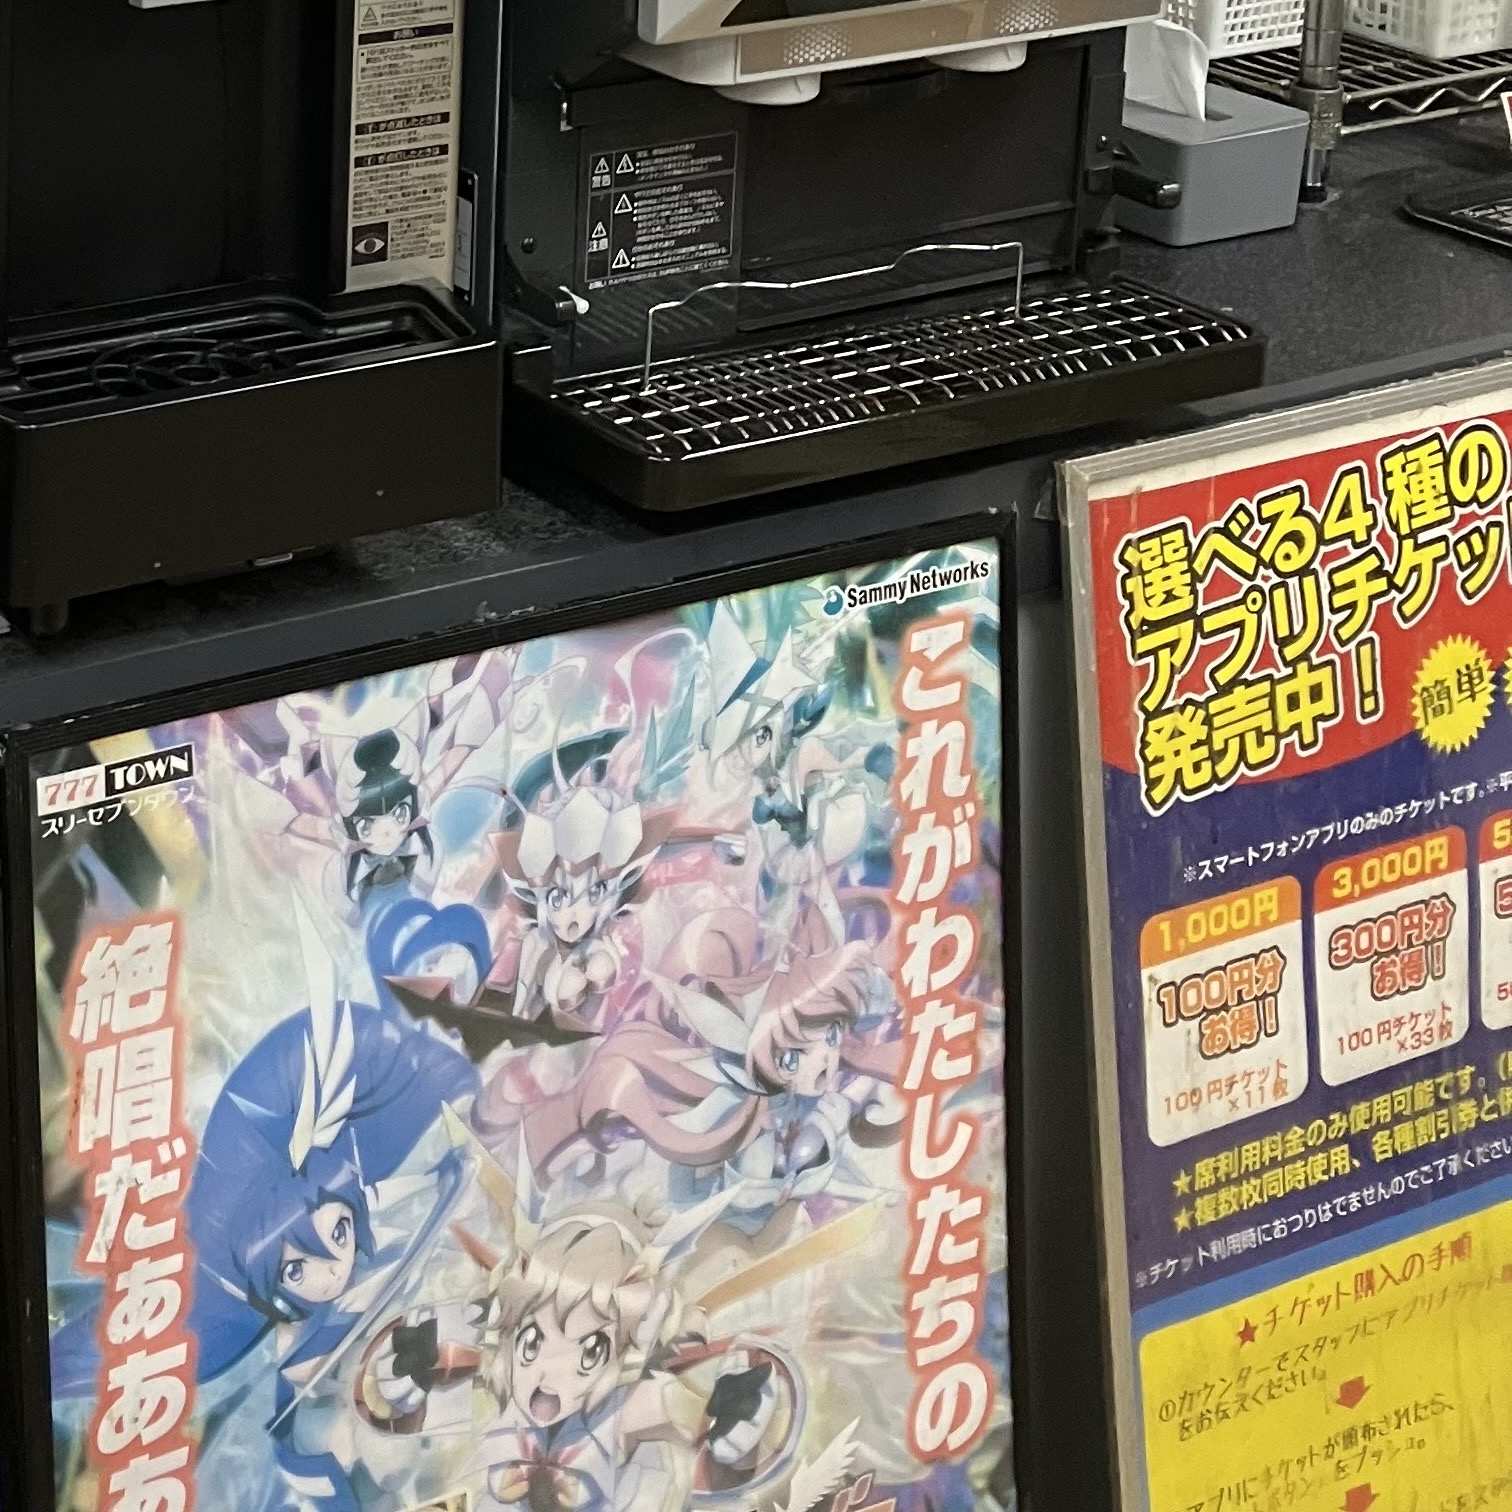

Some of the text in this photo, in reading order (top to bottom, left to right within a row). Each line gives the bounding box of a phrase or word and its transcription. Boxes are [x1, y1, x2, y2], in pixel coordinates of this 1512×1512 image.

[1118, 425, 1507, 631] 選べる4種の
[1131, 496, 1512, 712] アプリチケッ
[1144, 636, 1380, 806] 発売中！
[1419, 658, 1488, 725] 簡単
[41, 785, 196, 838] スリーセブンタウン
[44, 752, 189, 807] 777 TOWN
[1333, 836, 1450, 899] 3,000円
[1159, 886, 1279, 953] 1,000円
[1328, 891, 1457, 971] 300円分
[1158, 945, 1286, 1027] 100円分
[1370, 940, 1446, 1001] お得！
[894, 619, 988, 1453] これがわたしたちの
[1199, 992, 1279, 1060] お得！
